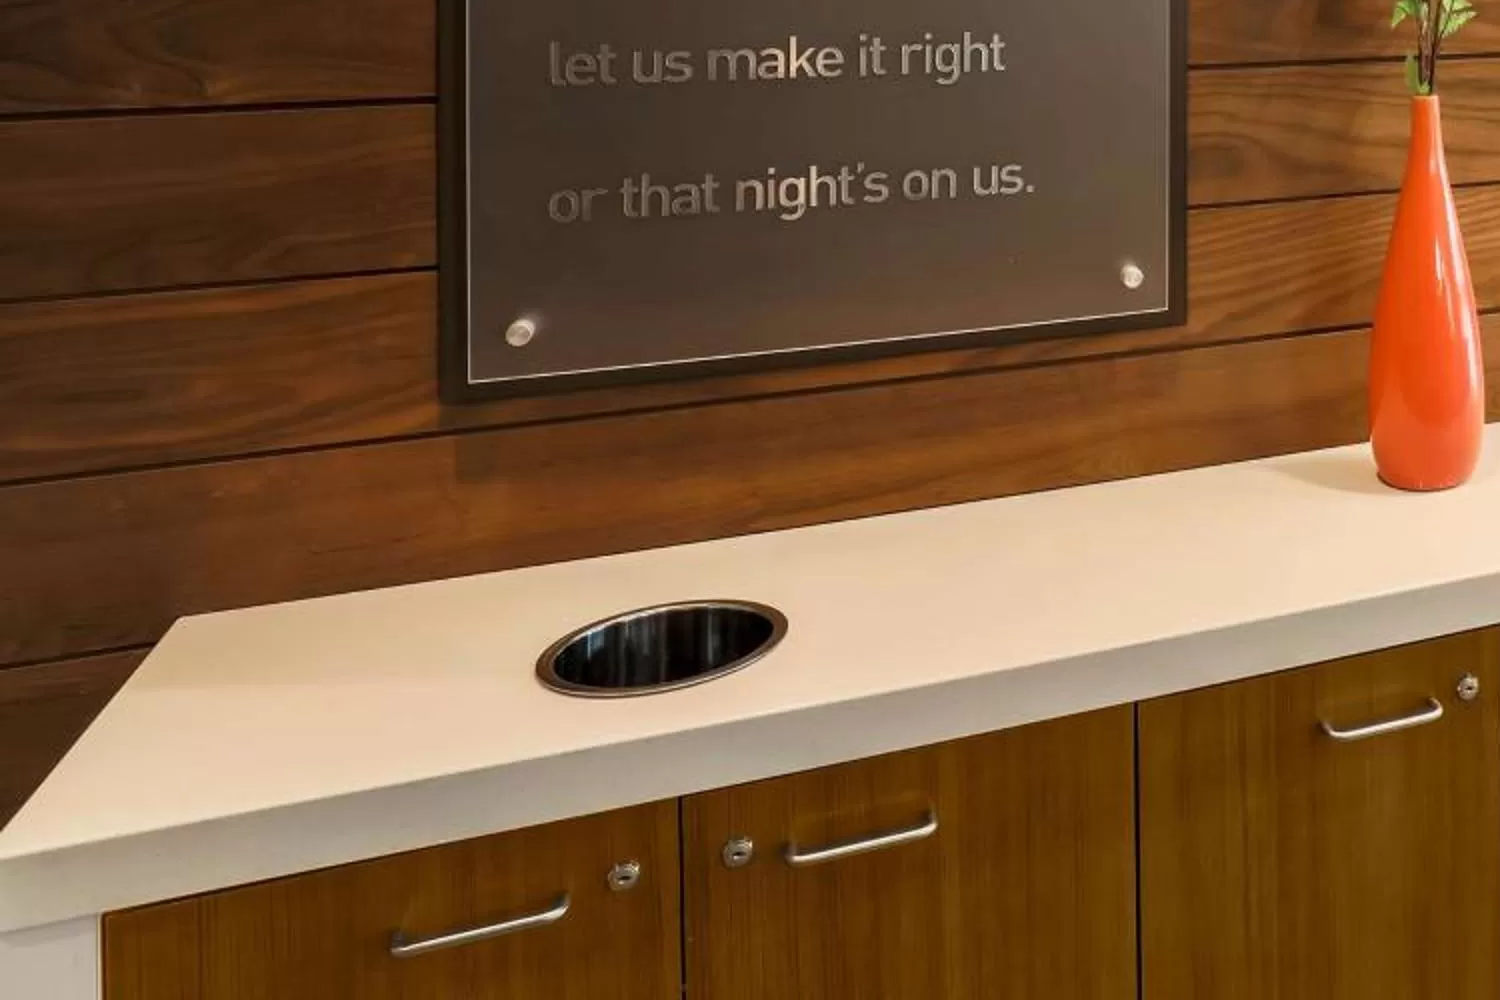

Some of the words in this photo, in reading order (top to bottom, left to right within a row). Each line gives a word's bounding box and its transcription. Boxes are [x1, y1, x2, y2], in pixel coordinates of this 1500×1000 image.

[549, 40, 617, 87] let
[632, 45, 693, 83] us
[707, 35, 844, 81] make
[858, 32, 887, 76] it
[900, 30, 1006, 86] right
[548, 186, 609, 223] or
[619, 172, 720, 219] that
[735, 161, 890, 220] night's
[903, 165, 957, 201] on
[972, 160, 1035, 196] us.
